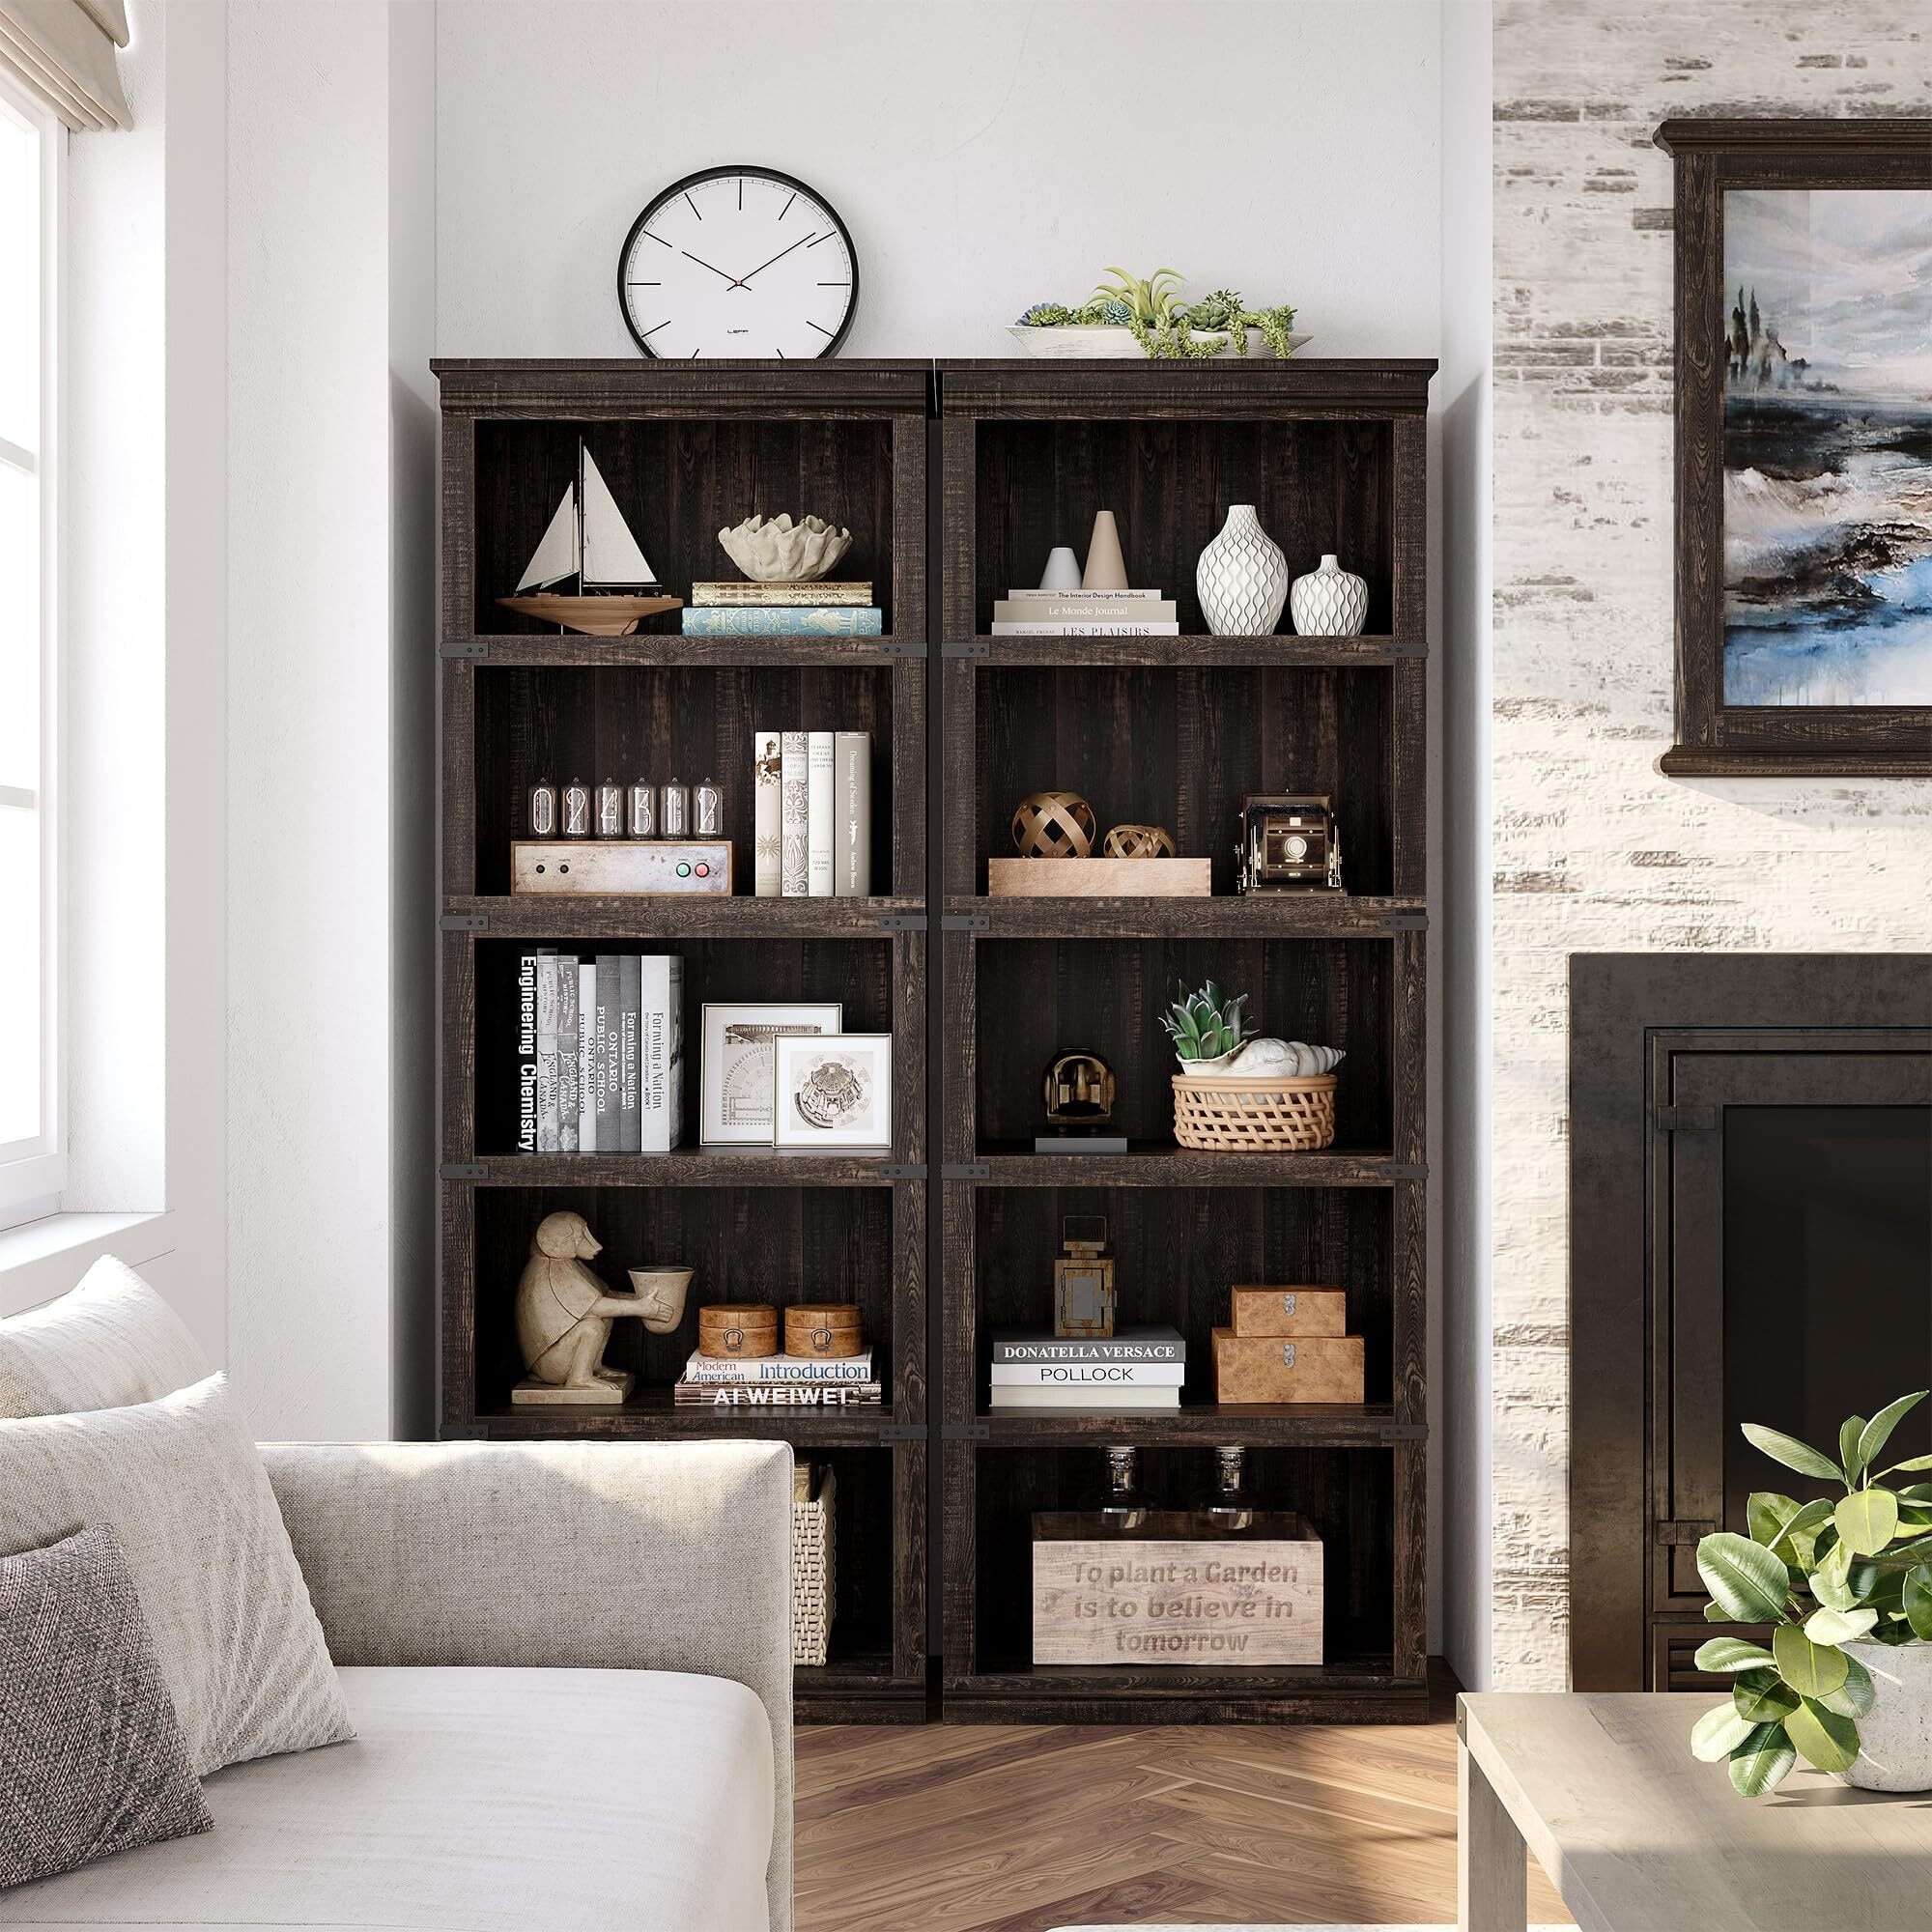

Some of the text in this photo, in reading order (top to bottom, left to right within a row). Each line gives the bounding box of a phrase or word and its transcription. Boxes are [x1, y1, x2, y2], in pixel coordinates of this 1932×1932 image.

[1049, 607, 1128, 616] Le Monde Journal
[1063, 627, 1085, 636] LES
[848, 751, 857, 781] Dreaming
[626, 1012, 637, 1061] Forming
[651, 1012, 664, 1061] Forming
[518, 956, 537, 1151] Engineering Chemistry
[609, 1032, 618, 1092] ONTARIO
[538, 1050, 557, 1100] ENGLAND
[558, 1050, 578, 1100] ENGLAND
[627, 1072, 637, 1110] Nation
[652, 1072, 664, 1110] Nation
[696, 1362, 736, 1371] Modern
[1004, 1347, 1176, 1358] DONATELLA VERSACE
[692, 1372, 745, 1381] American
[759, 1363, 869, 1379] Introduction
[1041, 1368, 1134, 1380] POLLOCK
[1072, 1560, 1298, 1588] To plant a Garden
[1074, 1596, 1293, 1618] is to believe in
[1115, 1629, 1249, 1652] tomorrow
